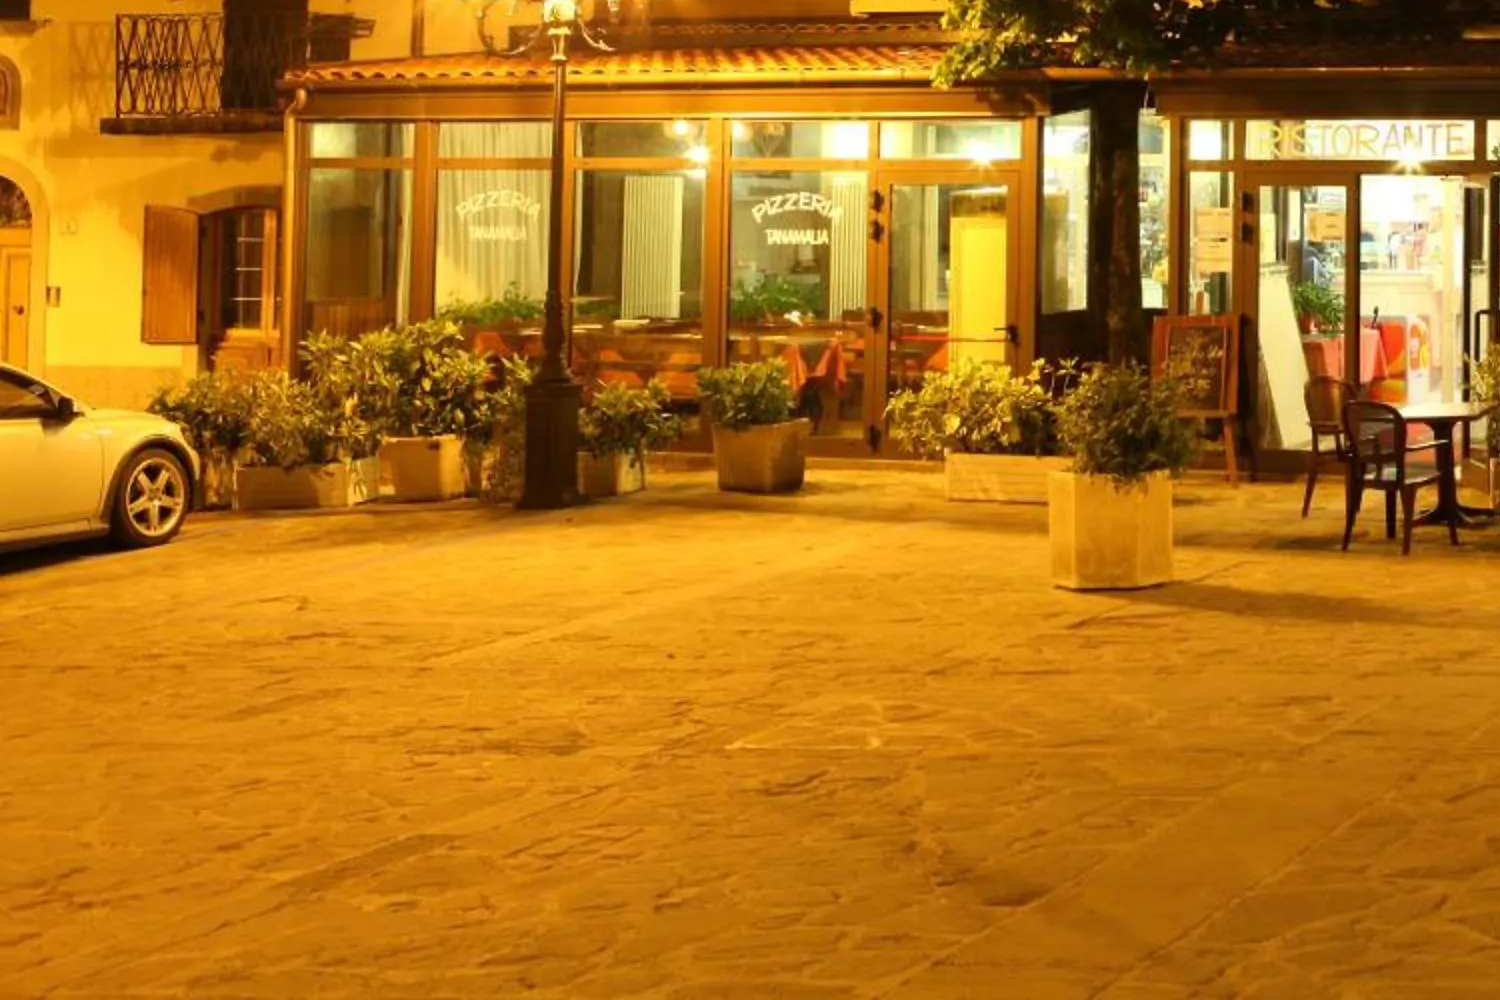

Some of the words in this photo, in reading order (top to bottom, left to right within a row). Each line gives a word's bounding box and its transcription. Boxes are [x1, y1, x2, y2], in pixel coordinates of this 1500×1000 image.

[1256, 122, 1466, 157] RISTORANTE
[456, 190, 541, 221] PIZZERIA
[752, 191, 842, 225] PIZZERIA
